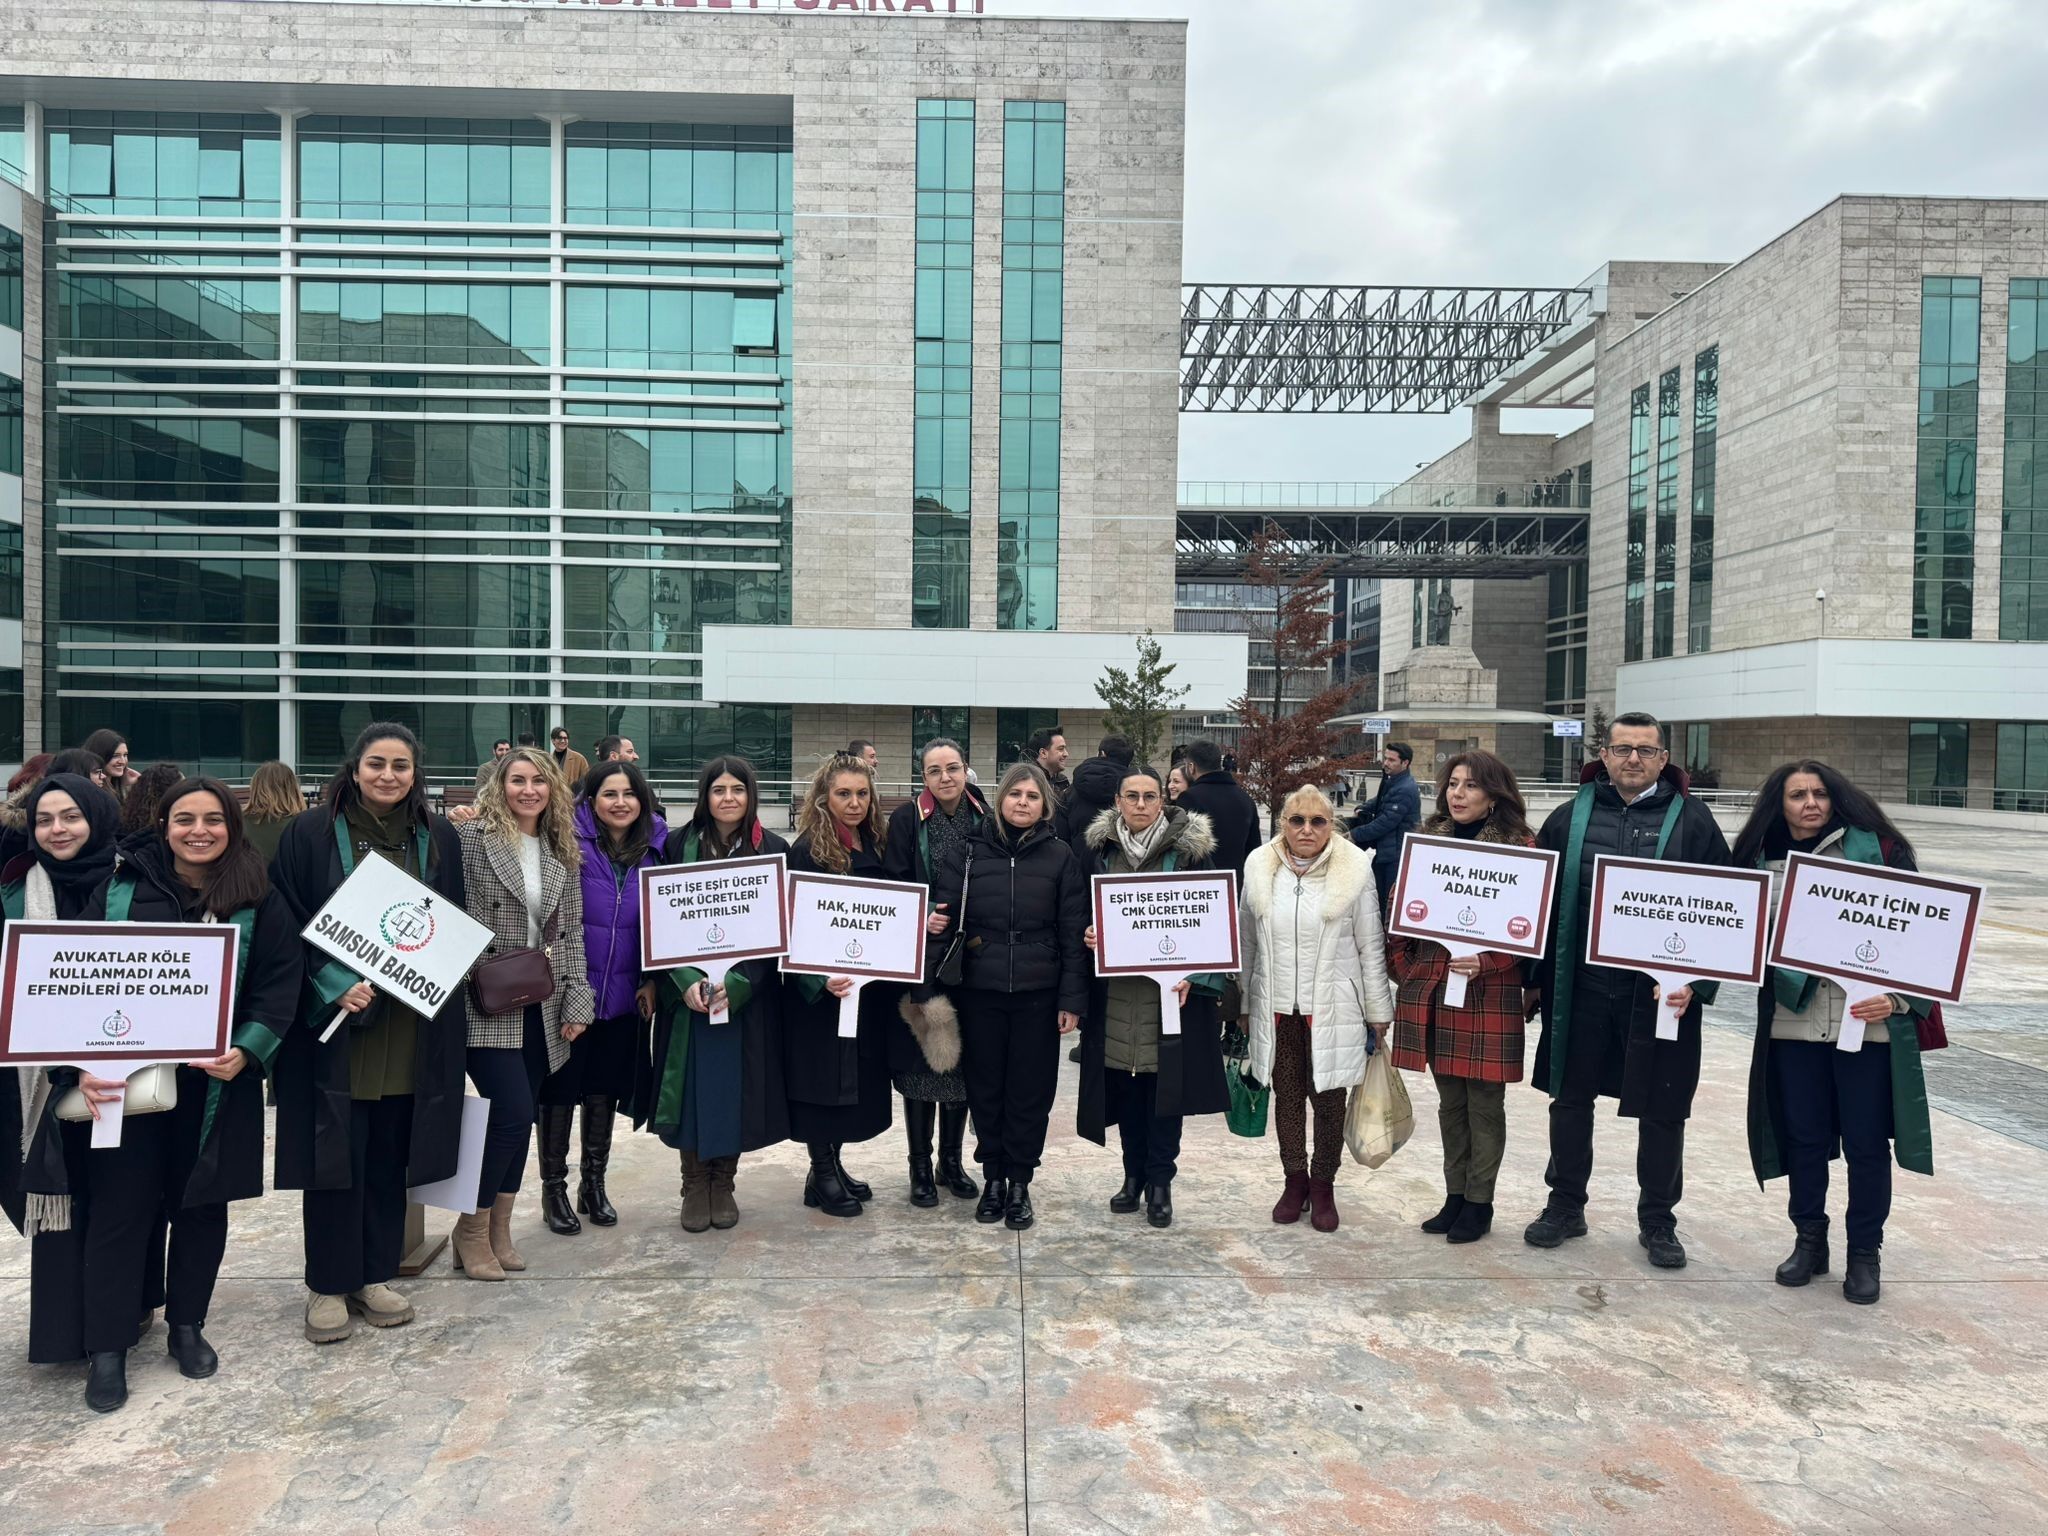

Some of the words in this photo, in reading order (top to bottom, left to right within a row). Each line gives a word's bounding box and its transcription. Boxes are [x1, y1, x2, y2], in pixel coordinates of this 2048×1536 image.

[1431, 863, 1464, 880] HAK,
[1468, 867, 1519, 886] HUKUK
[657, 882, 682, 896] EŞİT
[685, 881, 703, 894] İŞE
[705, 877, 730, 891] EŞİT
[732, 874, 769, 888] ÜCRET
[1443, 881, 1501, 900] ADALET
[669, 895, 694, 908] CMK
[696, 887, 759, 905] ÜCRETLERİ
[1109, 891, 1134, 905] EŞİT
[1136, 891, 1154, 903] İŞE
[1156, 889, 1181, 903] EŞİT
[1183, 889, 1220, 900] ÜCRET
[1621, 890, 1684, 907] AVUKATA
[1687, 895, 1738, 915] İTİBAR,
[1807, 883, 1880, 907] AVUKAT
[1883, 894, 1921, 916] İÇİN
[1924, 904, 1950, 921] DE
[679, 904, 750, 921] ARTTIRILSIN
[817, 899, 849, 914] HAK,
[852, 902, 897, 918] HUKUK
[1121, 906, 1146, 917] CMK
[1148, 902, 1210, 916] ÜCRETLERİ
[1613, 904, 1675, 921] MESLEĞE
[1677, 910, 1744, 930] GÜVENCE
[830, 916, 882, 932] ADALET
[1131, 918, 1201, 930] ARTTIRILSIN
[1838, 908, 1911, 933] ADALET
[52, 951, 147, 963] AVUKATLAR
[151, 949, 191, 963] KÖLE
[315, 913, 385, 968] SAMSUN
[380, 955, 447, 1008] BAROSU
[1840, 960, 1864, 969] SAMSUN
[49, 967, 153, 979] KULLANMADI
[156, 968, 191, 979] AMA
[27, 982, 121, 996] EFENDİLERİ
[124, 984, 146, 996] DE
[149, 984, 209, 995] OLMADI
